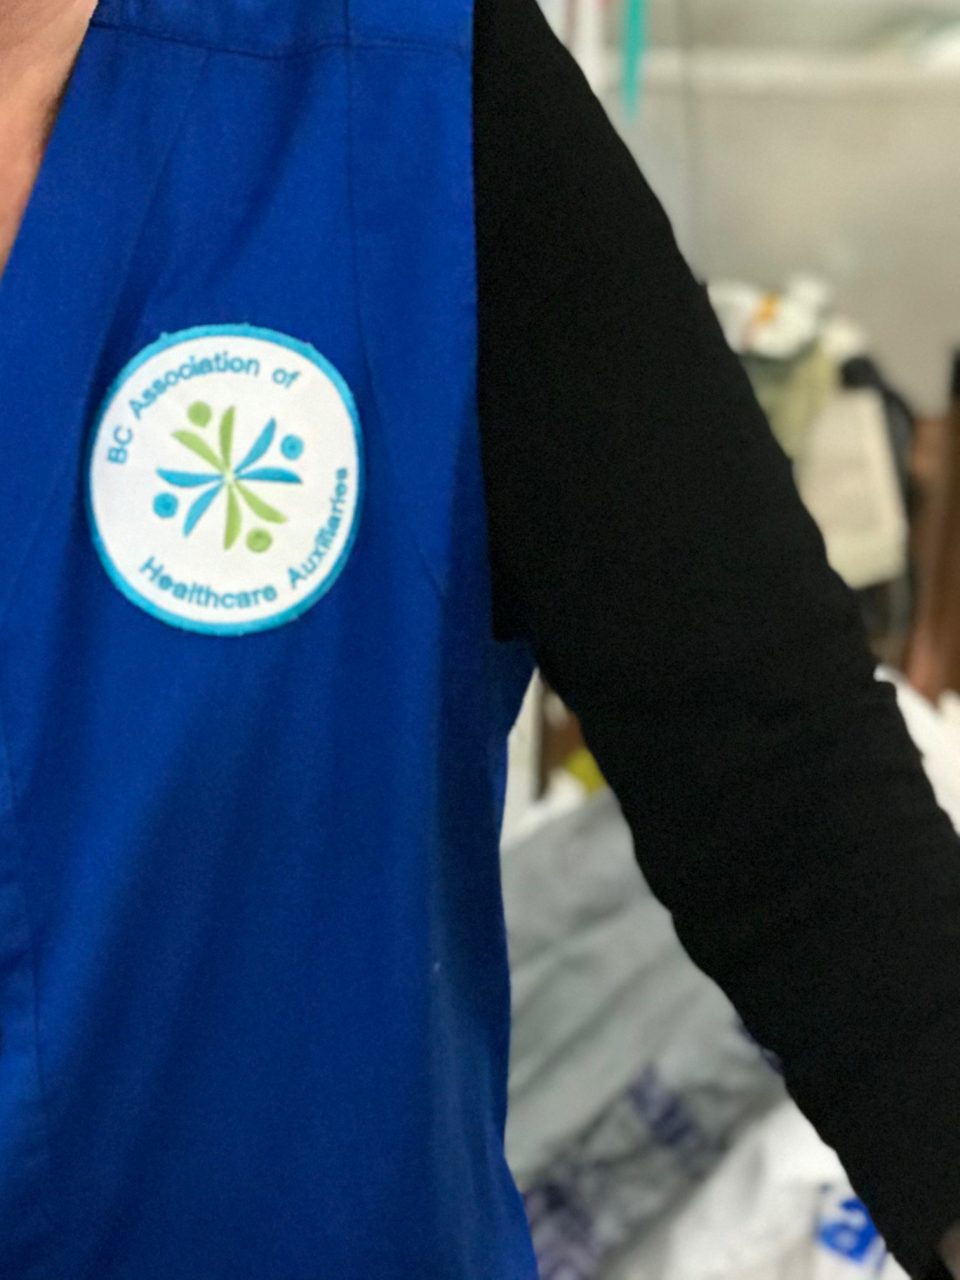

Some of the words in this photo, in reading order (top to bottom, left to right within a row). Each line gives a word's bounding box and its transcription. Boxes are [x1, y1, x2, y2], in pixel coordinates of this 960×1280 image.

[106, 425, 133, 464] BC
[128, 351, 260, 421] Association
[272, 368, 301, 389] of
[139, 556, 278, 609] Healthcare
[287, 467, 348, 590] Auxiliaries
